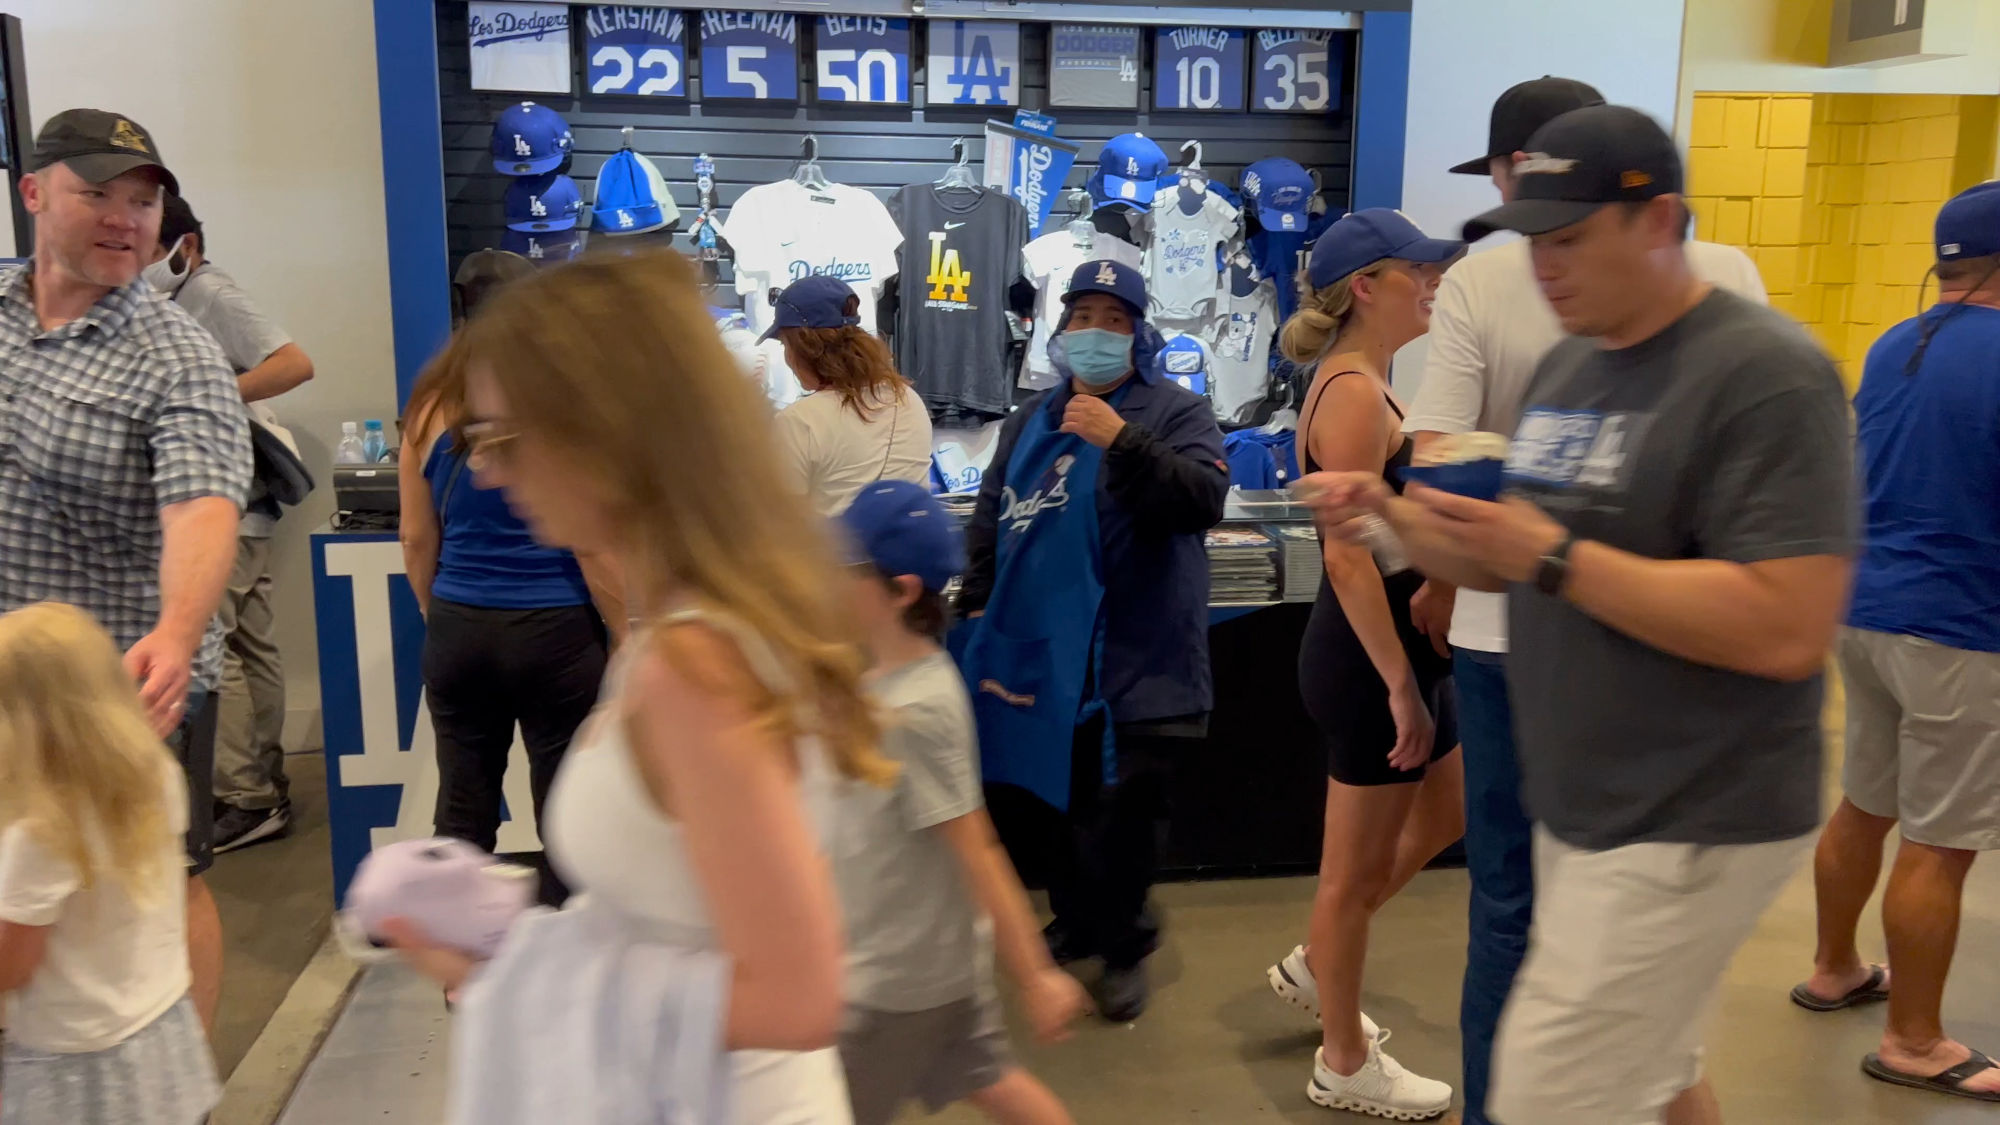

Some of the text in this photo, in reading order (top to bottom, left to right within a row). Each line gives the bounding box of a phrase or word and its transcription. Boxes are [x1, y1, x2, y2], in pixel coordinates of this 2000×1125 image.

[468, 11, 568, 41] Los Dodgers
[1169, 26, 1229, 52] TURNER
[592, 46, 679, 95] 22
[726, 46, 767, 98] 5
[816, 49, 897, 102] 50
[947, 20, 1010, 105] LA
[1119, 55, 1137, 81] LA
[1176, 57, 1219, 109] 10
[1264, 52, 1329, 111] 35
[514, 134, 531, 155] LA
[1126, 156, 1139, 176] LA
[1015, 143, 1052, 229] Dodgers
[530, 195, 547, 216] LA
[617, 210, 634, 227] LA
[528, 237, 544, 258] LA
[789, 256, 872, 284] Dodgers
[926, 231, 971, 302] LA
[1095, 261, 1117, 286] LA
